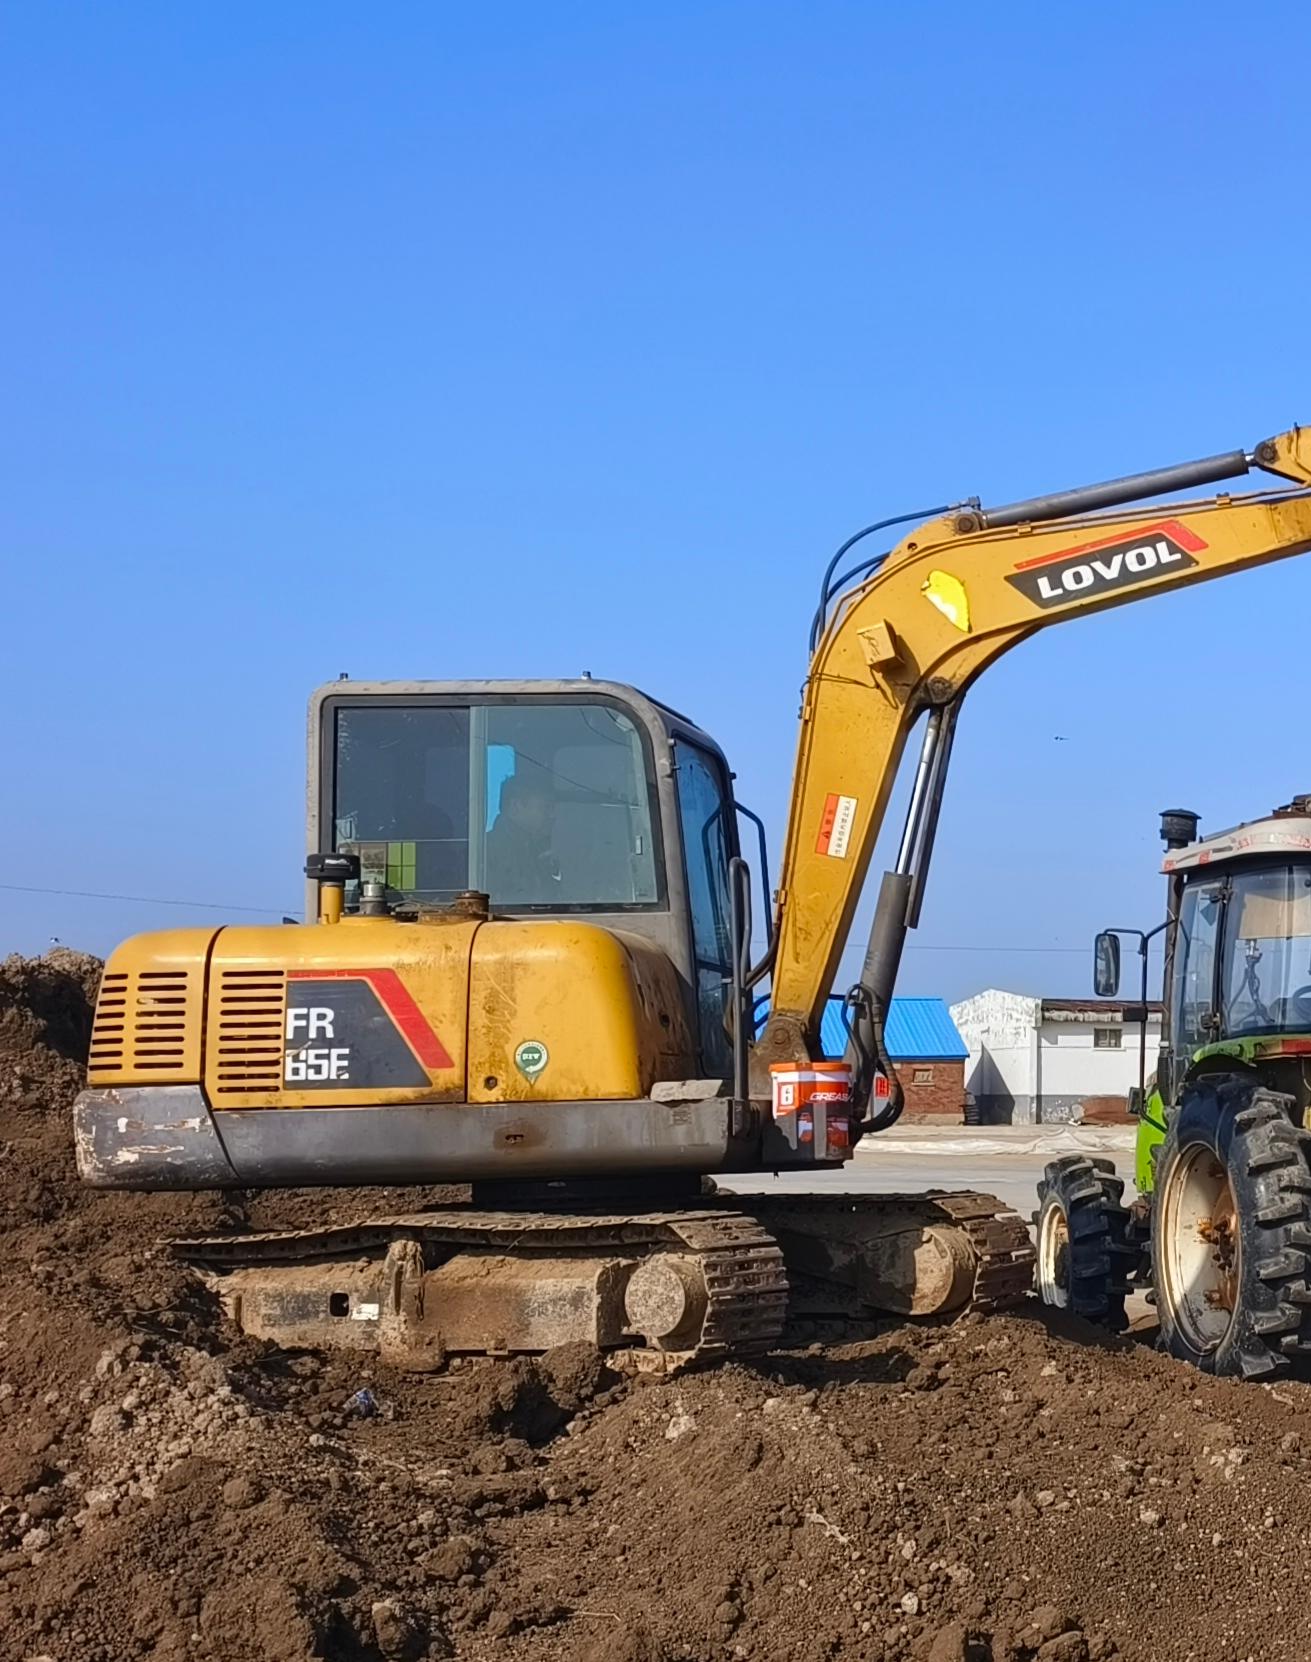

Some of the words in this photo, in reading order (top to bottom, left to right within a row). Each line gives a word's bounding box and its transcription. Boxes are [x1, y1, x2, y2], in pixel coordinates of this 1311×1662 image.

[1037, 541, 1182, 600] LOVOL
[286, 1007, 335, 1040] FR
[285, 1047, 350, 1081] 65E
[809, 1091, 853, 1102] GREAS
